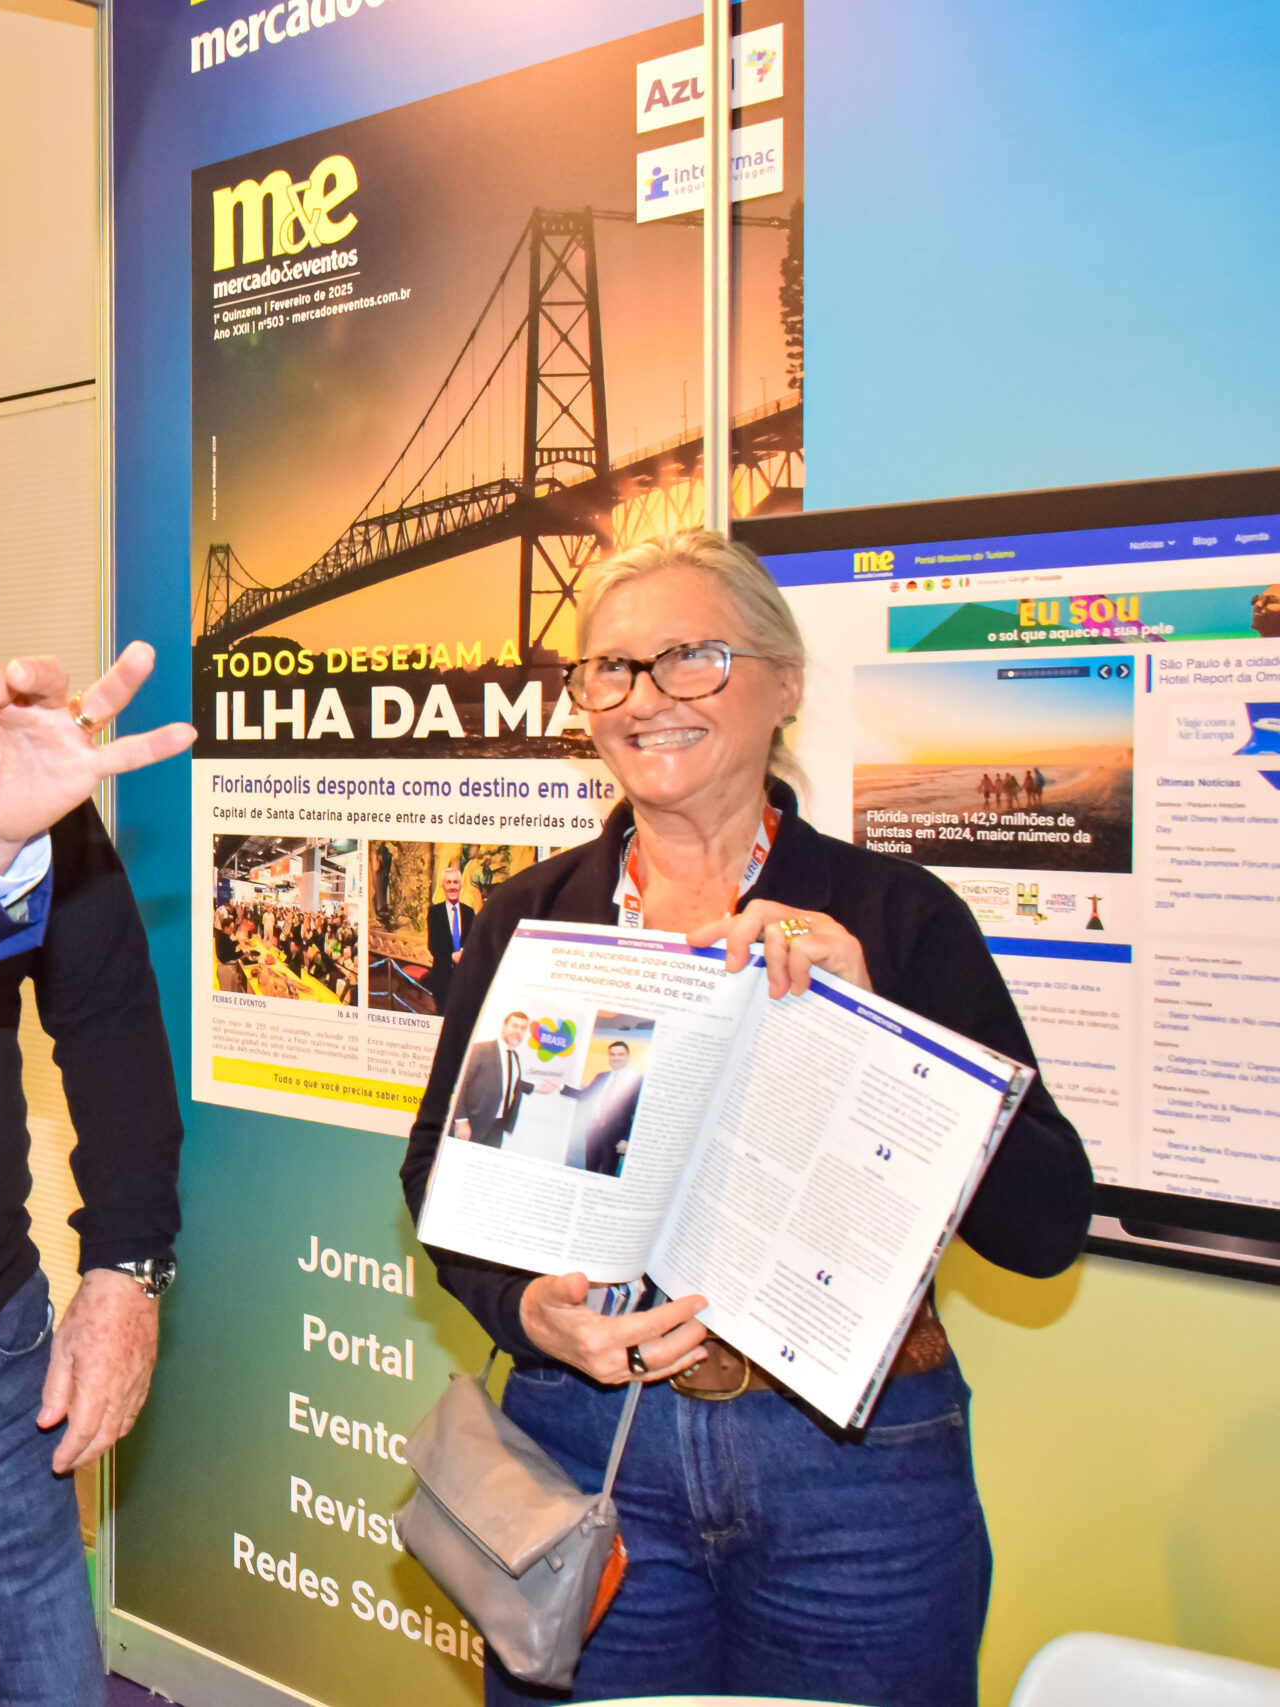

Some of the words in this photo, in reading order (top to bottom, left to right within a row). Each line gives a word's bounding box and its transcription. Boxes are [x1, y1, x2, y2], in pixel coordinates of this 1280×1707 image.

[212, 154, 359, 272] m&e
[213, 248, 359, 299] mercado&eventos
[213, 326, 231, 341] Ano
[232, 322, 250, 337] XXII
[292, 287, 412, 324] mercadoeeventos.com.br
[222, 306, 262, 323] Quinzena
[269, 294, 311, 312] Fevereiro
[313, 290, 326, 302] de
[328, 283, 353, 299] 2025
[1192, 536, 1218, 547] Blogs
[1234, 532, 1270, 544] Agenda
[1019, 600, 1061, 627] EU
[1069, 596, 1140, 624] SOU
[988, 631, 997, 642] o
[999, 629, 1019, 642] sol
[1020, 630, 1047, 645] que
[1049, 627, 1099, 643] aquece
[1102, 626, 1111, 637] a
[1113, 625, 1138, 637] sua
[1140, 622, 1174, 639] pele
[212, 648, 315, 678] TODOS
[326, 641, 483, 674] DESEJAM
[496, 639, 522, 667] A
[1160, 658, 1183, 670] São
[1186, 658, 1220, 669] Paulo
[1224, 657, 1231, 668] é
[1235, 659, 1242, 667] a
[1160, 673, 1189, 684] Hotel
[1193, 673, 1233, 686] Report
[1237, 672, 1252, 683] da
[215, 687, 355, 741] ILHA
[370, 684, 465, 739] DA
[483, 680, 592, 738] MA
[212, 774, 311, 798] Florianópolis
[317, 776, 396, 800] desponta
[402, 780, 452, 796] como
[459, 777, 530, 798] destino
[538, 782, 569, 798] em
[577, 778, 615, 799] alta
[213, 806, 246, 820] Capital
[250, 807, 262, 819] de
[266, 808, 295, 820] Santa
[298, 808, 342, 821] Catarina
[346, 811, 391, 824] aparece
[396, 812, 426, 824] entre
[430, 814, 443, 824] as
[448, 812, 495, 826] cidades
[499, 813, 565, 829] preferidas
[571, 815, 594, 828] dos
[866, 811, 908, 824] Flórida
[911, 811, 959, 827] registra
[962, 813, 997, 827] 142,9
[1000, 812, 1054, 827] milhões
[1057, 813, 1075, 827] de
[866, 826, 912, 839] turistas
[915, 829, 935, 839] em
[938, 827, 974, 842] 2024,
[976, 829, 1014, 842] maior
[1018, 830, 1070, 843] número
[1073, 830, 1091, 844] da
[866, 840, 912, 854] história
[625, 911, 639, 928] BP
[551, 947, 586, 958] BRASIL
[589, 949, 639, 963] ENCERRA
[641, 956, 668, 967] 2024
[669, 960, 696, 972] COM
[697, 965, 728, 978] MAIS
[555, 959, 568, 968] DE
[593, 962, 641, 978] MILHÕES
[642, 969, 658, 980] DE
[660, 972, 716, 990] TURISTAS
[212, 995, 232, 1005] FEIRAS
[239, 998, 267, 1009] EVENTOS
[635, 984, 661, 995] ALTA
[663, 987, 679, 998] DE
[367, 1013, 391, 1024] FEIRAS
[392, 1016, 397, 1024] E
[398, 1017, 431, 1029] EVENTOS
[540, 1032, 567, 1047] BRASIL
[274, 1074, 292, 1084] Tudo
[303, 1080, 318, 1089] que
[321, 1082, 340, 1092] você
[342, 1085, 373, 1098] precisa
[376, 1090, 399, 1101] saber
[402, 1094, 422, 1104] sobr
[298, 1235, 415, 1297] Jornal
[303, 1313, 415, 1381] Portal
[288, 1391, 408, 1465] Evento
[290, 1474, 404, 1553] Revist
[232, 1531, 340, 1608] Redes
[350, 1579, 485, 1669] Sociais
